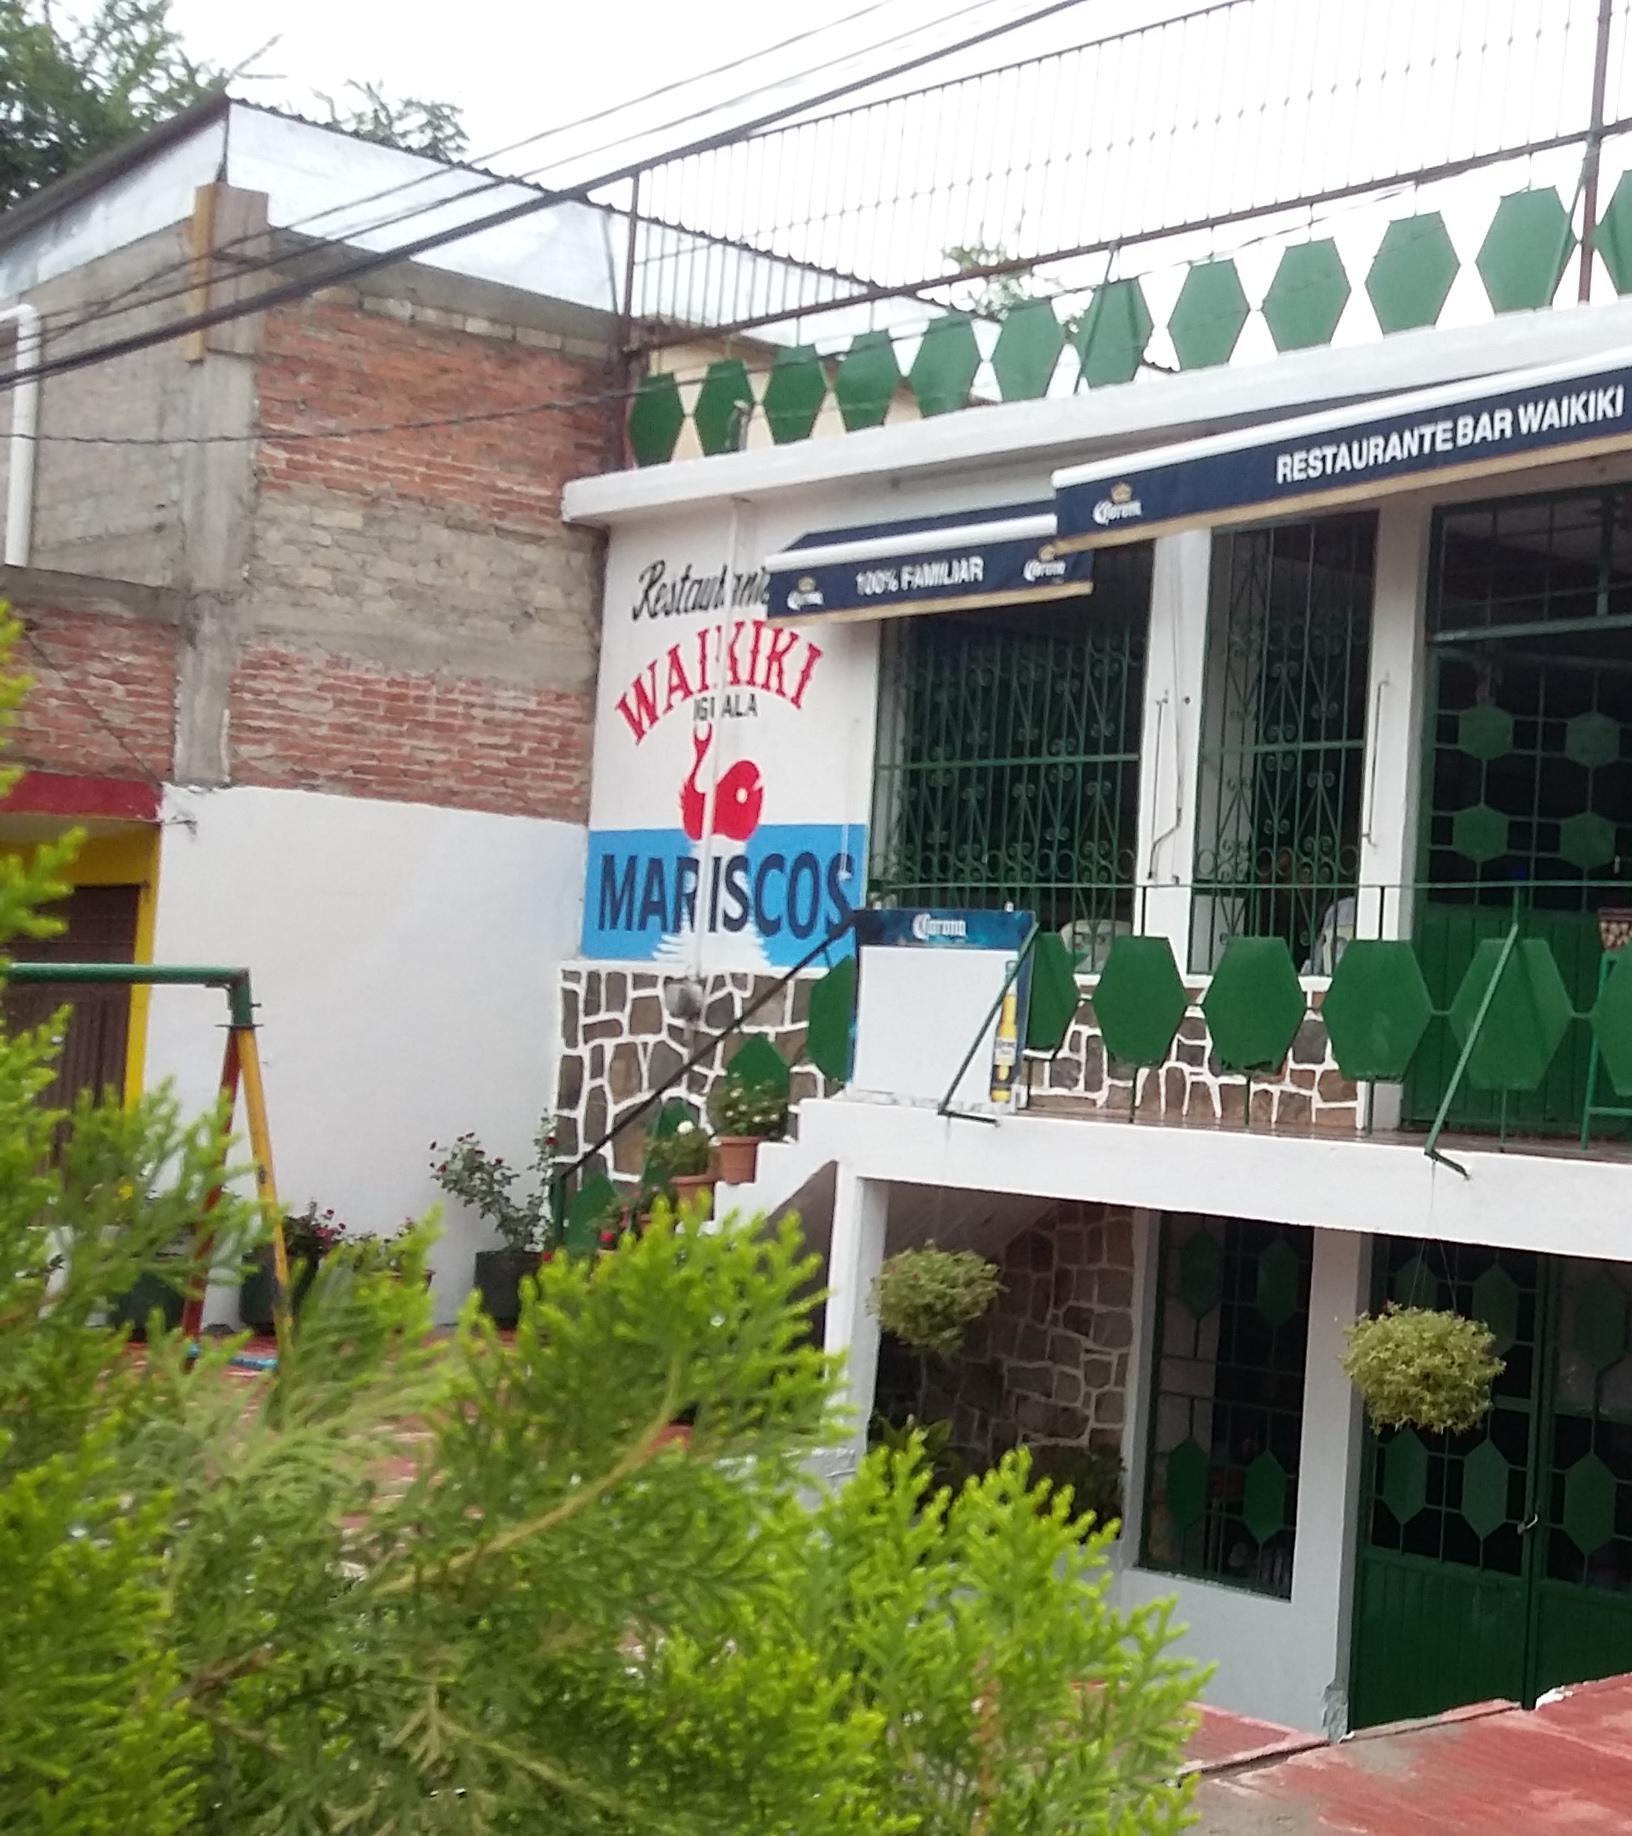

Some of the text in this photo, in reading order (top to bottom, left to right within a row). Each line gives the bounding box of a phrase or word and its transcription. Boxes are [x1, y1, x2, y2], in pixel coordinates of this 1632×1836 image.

[1275, 385, 1625, 484] RESTAURANTE BAR WAIKIKI
[856, 556, 984, 595] 100% FAMILIAR
[598, 851, 855, 940] MARISCOS
[912, 913, 966, 940] Corona
